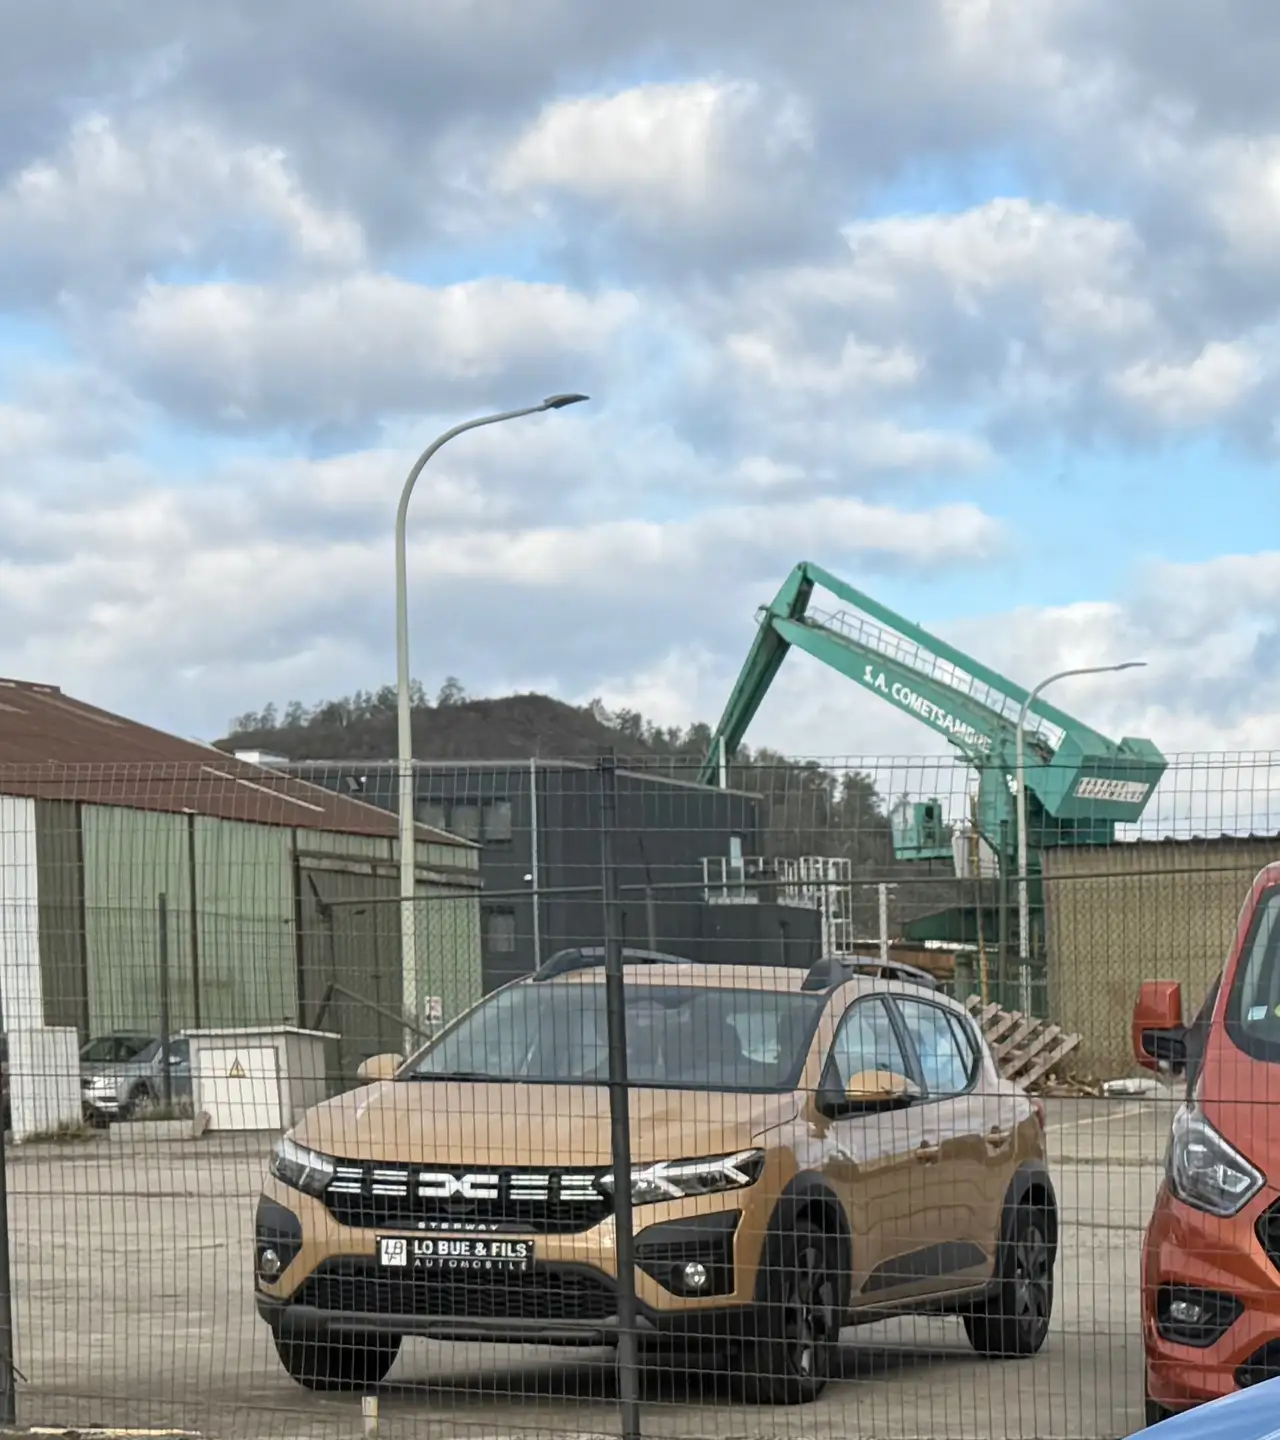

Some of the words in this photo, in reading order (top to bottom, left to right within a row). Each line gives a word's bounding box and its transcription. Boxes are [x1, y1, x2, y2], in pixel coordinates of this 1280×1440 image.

[414, 1239, 433, 1255] LO
[438, 1240, 470, 1255] BUE
[475, 1241, 487, 1257] &
[491, 1242, 527, 1257] FILS
[414, 1259, 527, 1270] AUTOMOBILE
